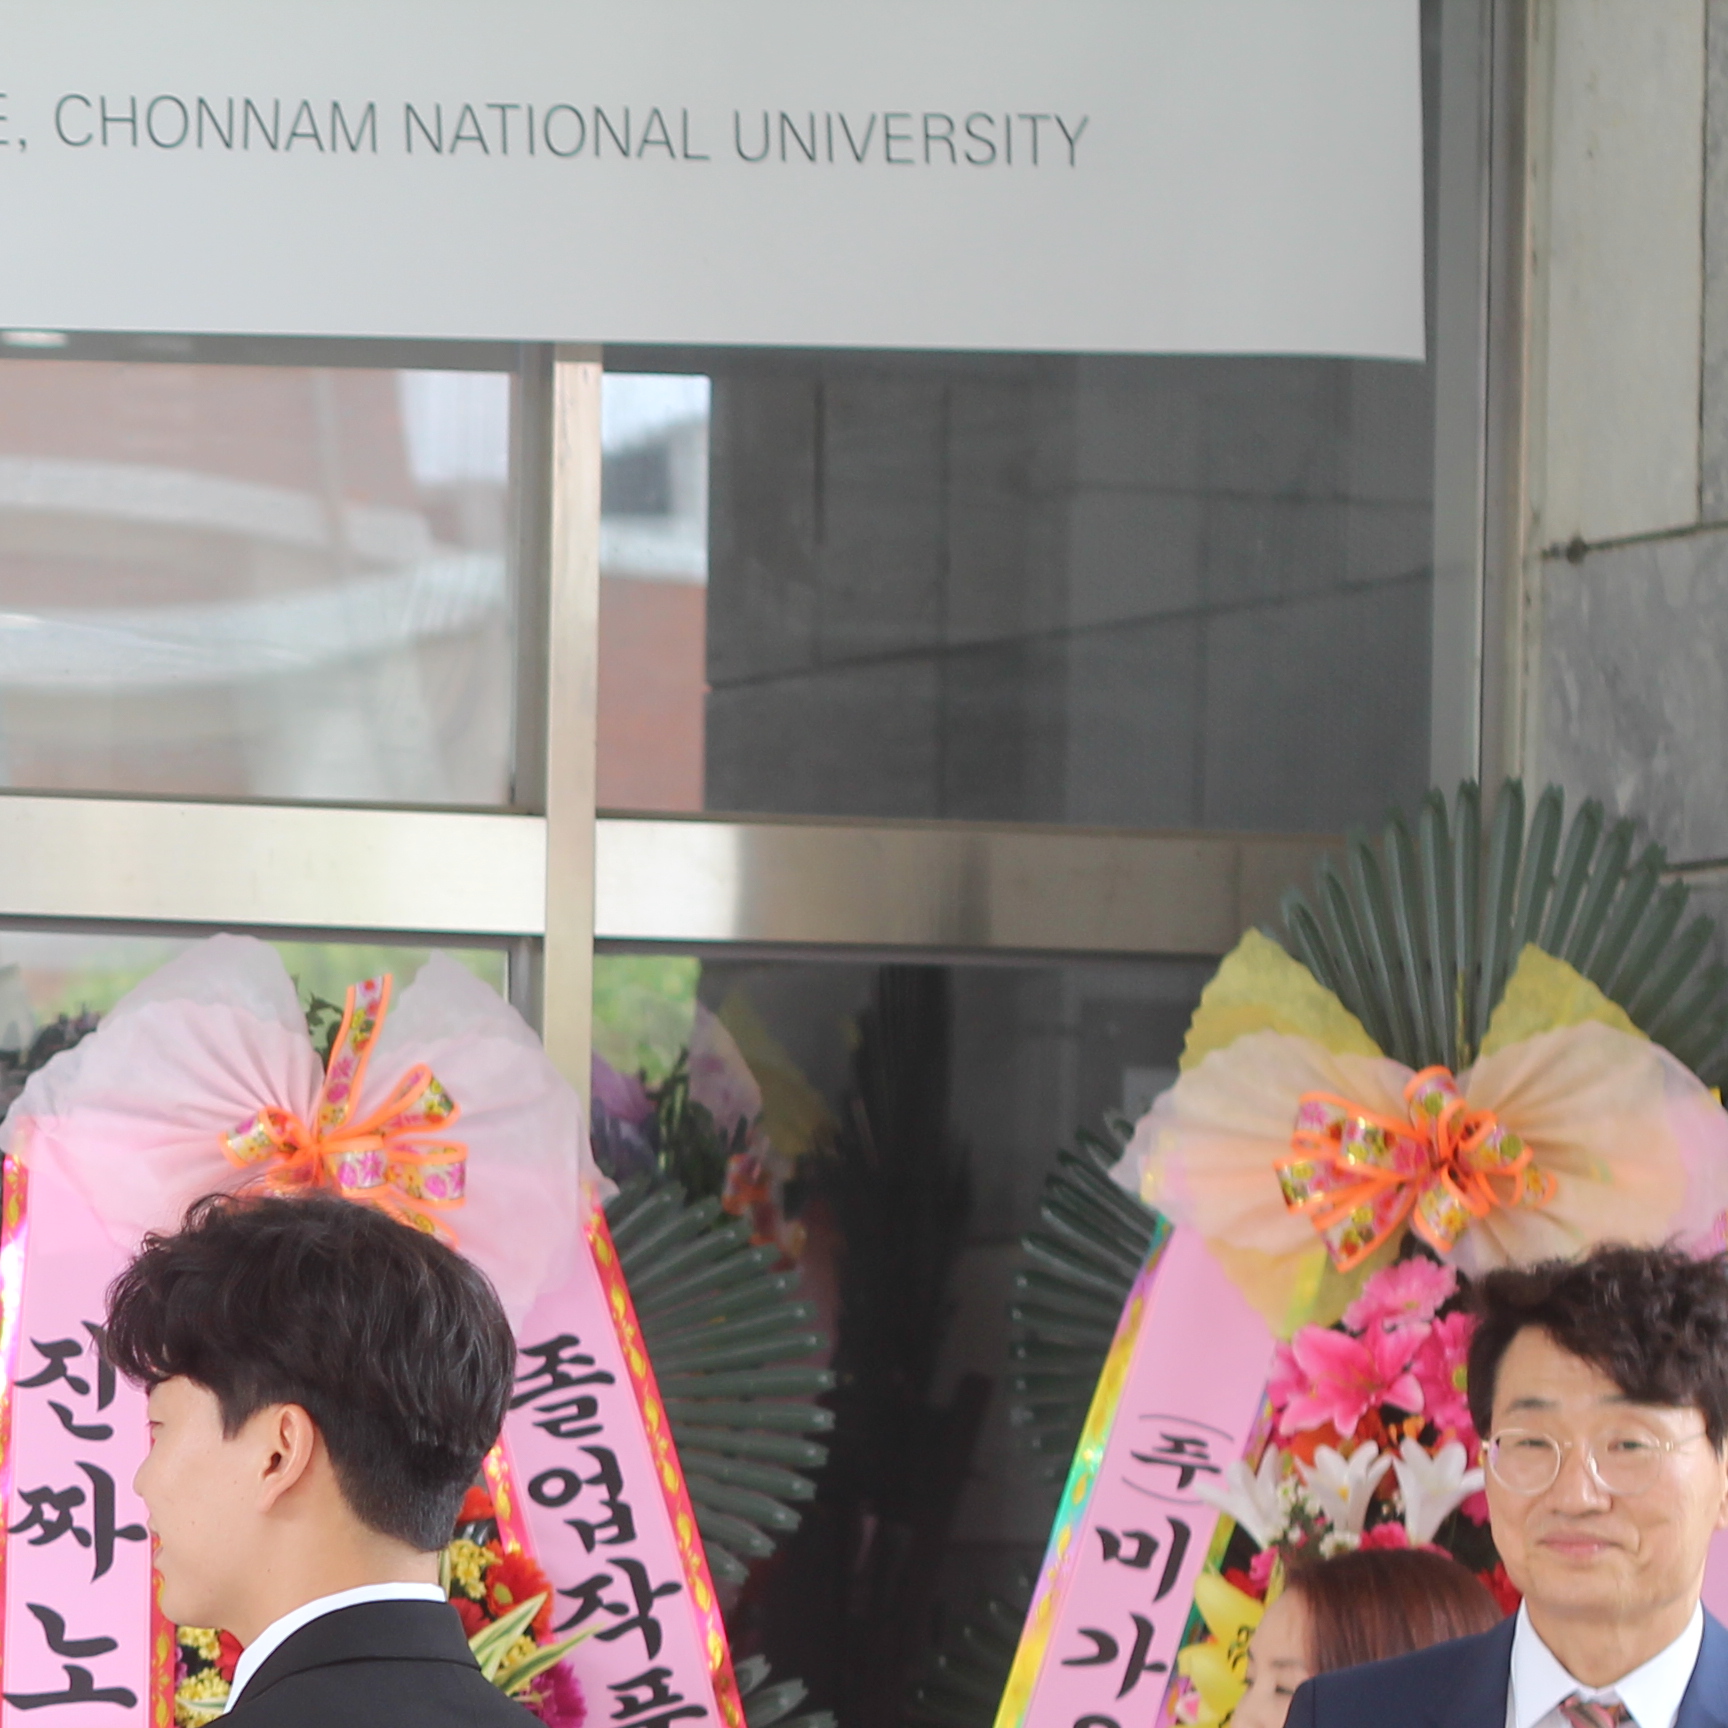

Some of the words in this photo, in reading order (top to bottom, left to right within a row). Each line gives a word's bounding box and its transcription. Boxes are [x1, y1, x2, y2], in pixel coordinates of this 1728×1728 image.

[53, 92, 379, 155] CHONNAM
[403, 101, 711, 162] NATIONAL
[734, 109, 1090, 169] UNIVERSITY
